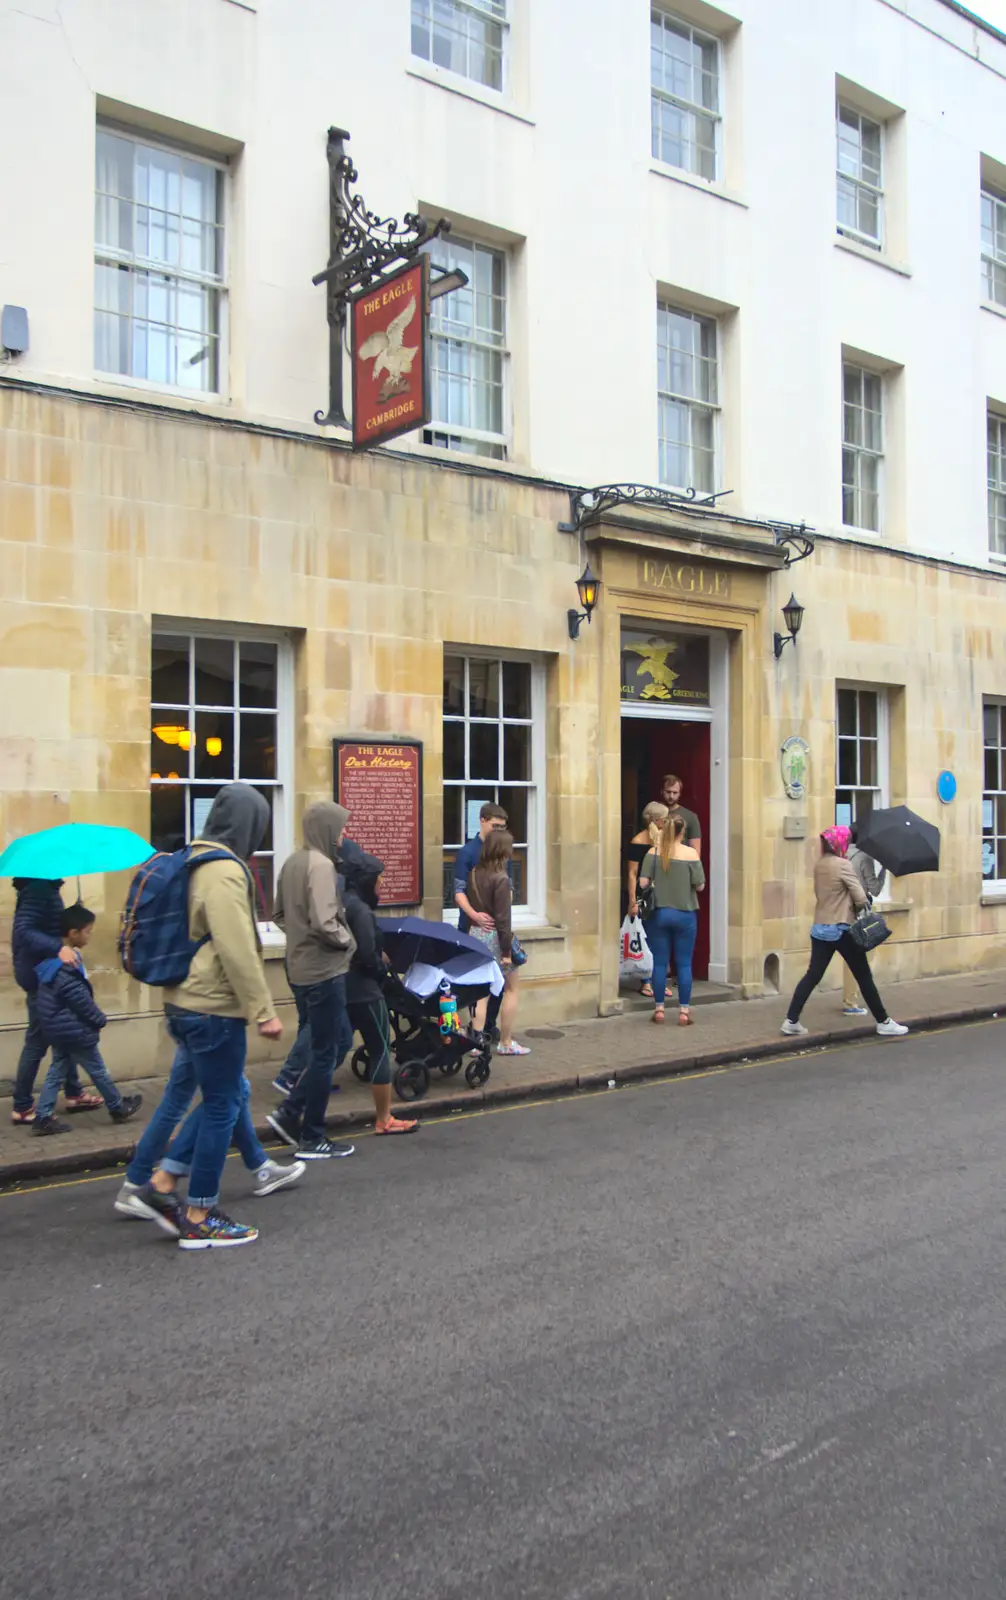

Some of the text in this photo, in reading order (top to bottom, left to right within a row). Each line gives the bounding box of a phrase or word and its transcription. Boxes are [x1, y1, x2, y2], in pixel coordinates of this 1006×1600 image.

[364, 279, 413, 316] THE EAGLE
[366, 400, 414, 429] CAMBRIDGE
[643, 560, 729, 597] EAGLE
[345, 757, 412, 769] Our History
[358, 747, 404, 756] THE EAGLE
